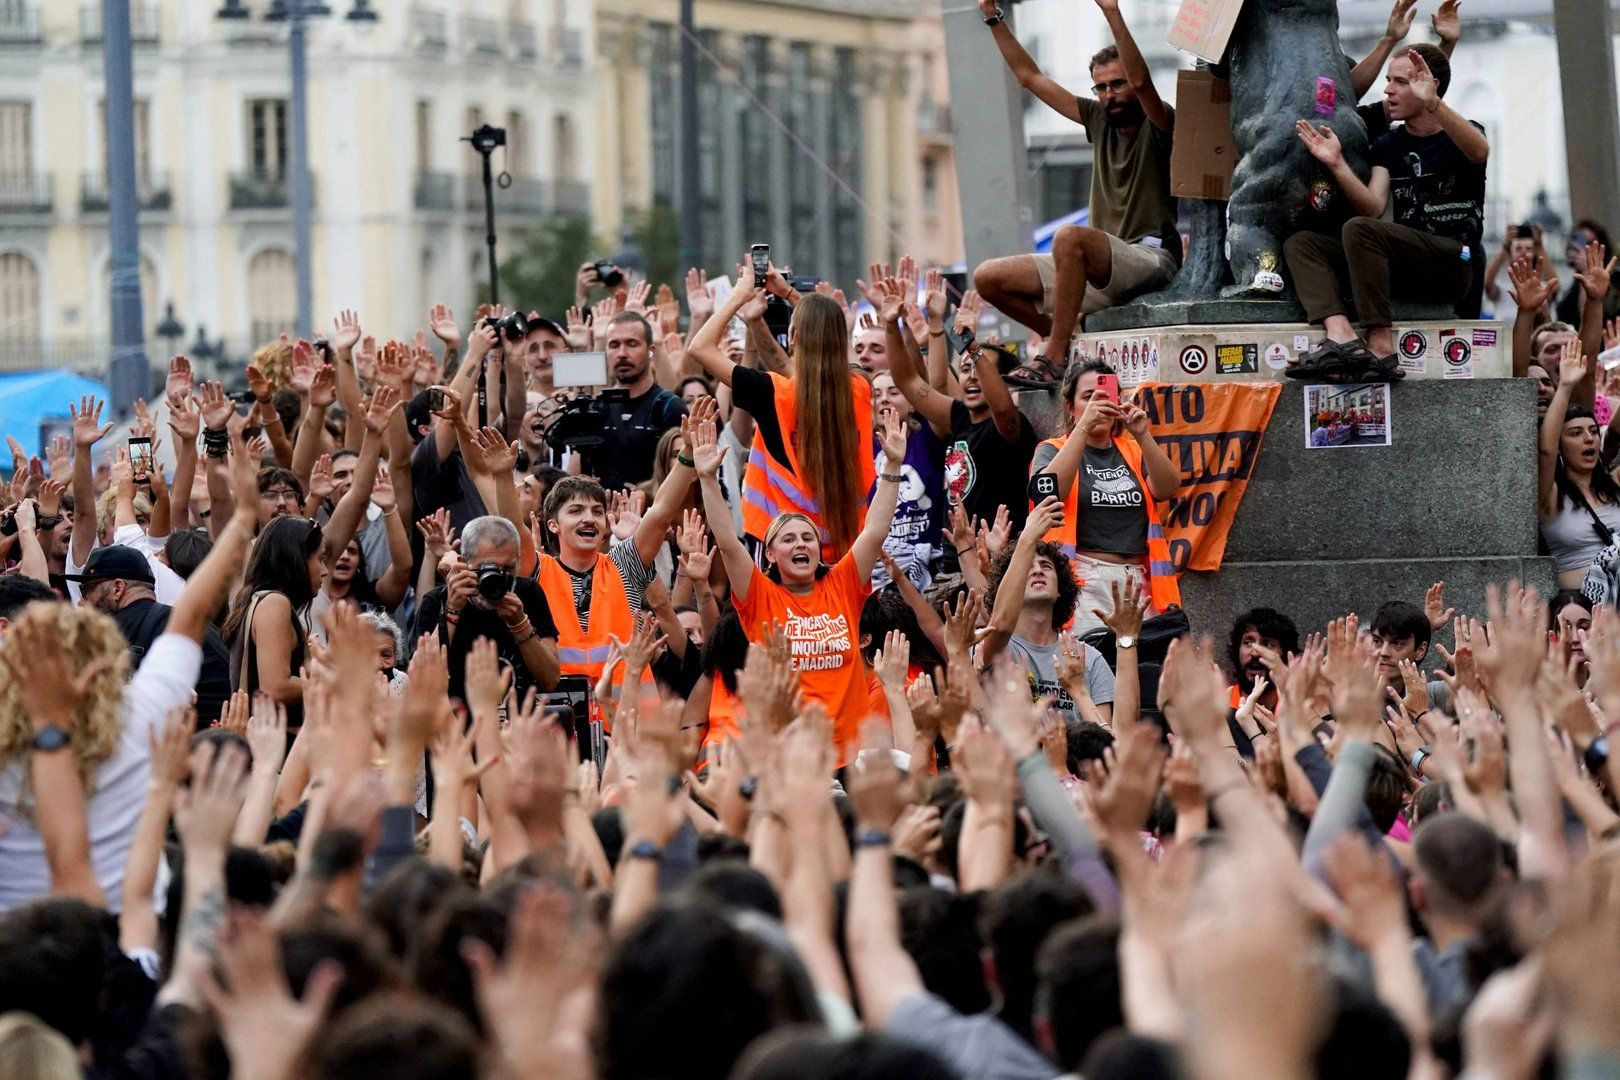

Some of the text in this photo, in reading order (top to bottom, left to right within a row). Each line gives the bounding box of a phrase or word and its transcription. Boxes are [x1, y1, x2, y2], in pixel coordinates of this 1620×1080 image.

[1217, 346, 1243, 357] LIBERAR
[1220, 355, 1244, 366] MADRID
[1133, 384, 1204, 425] ATO
[1091, 490, 1143, 507] BARRIO
[791, 636, 852, 657] INQUILINOS
[800, 654, 844, 671] MADRID
